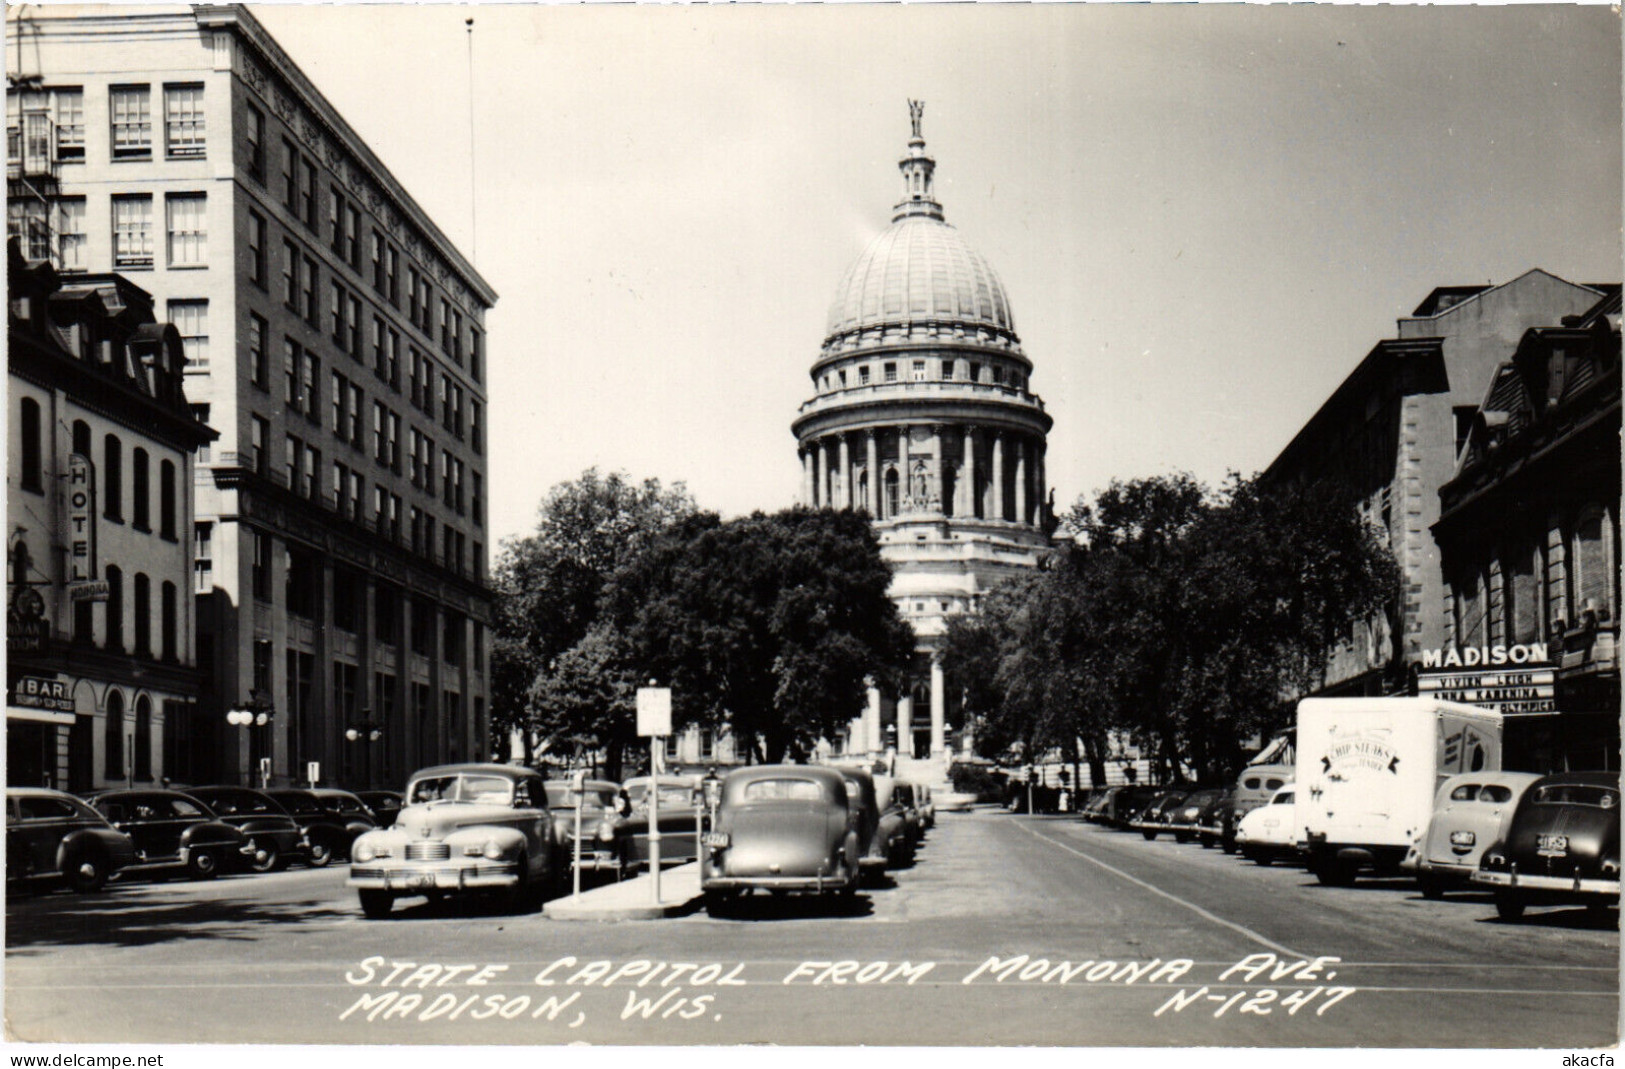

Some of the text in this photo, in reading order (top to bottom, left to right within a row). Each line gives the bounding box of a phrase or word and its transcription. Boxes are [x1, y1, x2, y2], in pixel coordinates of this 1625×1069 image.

[72, 467, 87, 580] HOTEL
[1422, 642, 1548, 668] MADISON
[27, 680, 63, 698] BAR
[1440, 674, 1532, 688] VIVIEN LEIGH
[1477, 688, 1539, 700] KARENINA
[1501, 702, 1554, 714] OLYMPICS
